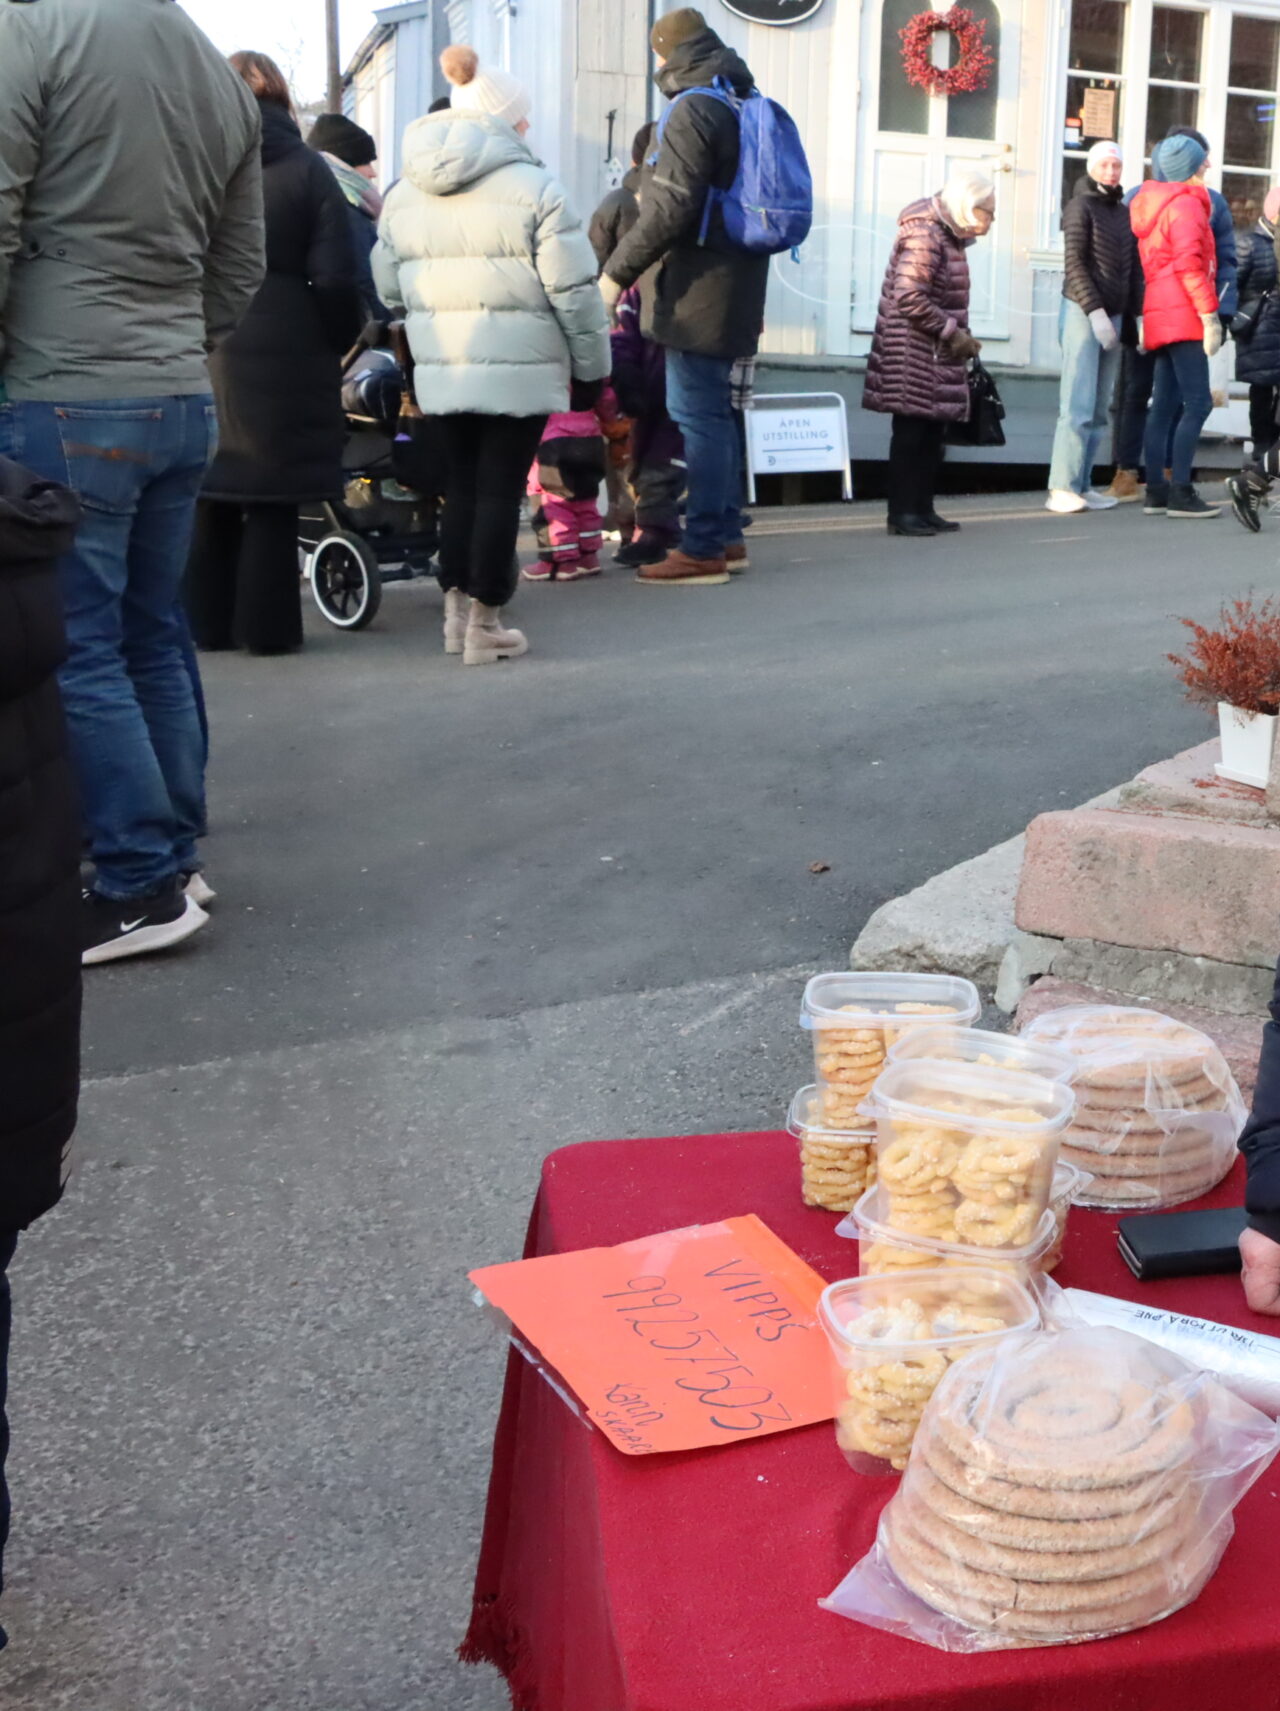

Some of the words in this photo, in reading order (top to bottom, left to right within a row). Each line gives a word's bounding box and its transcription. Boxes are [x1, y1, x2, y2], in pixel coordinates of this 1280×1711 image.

[762, 430, 829, 441] UTSTILLING
[779, 418, 811, 429] ÅPEN
[703, 1258, 810, 1342] VIPPS
[602, 1274, 793, 1431] 99257503
